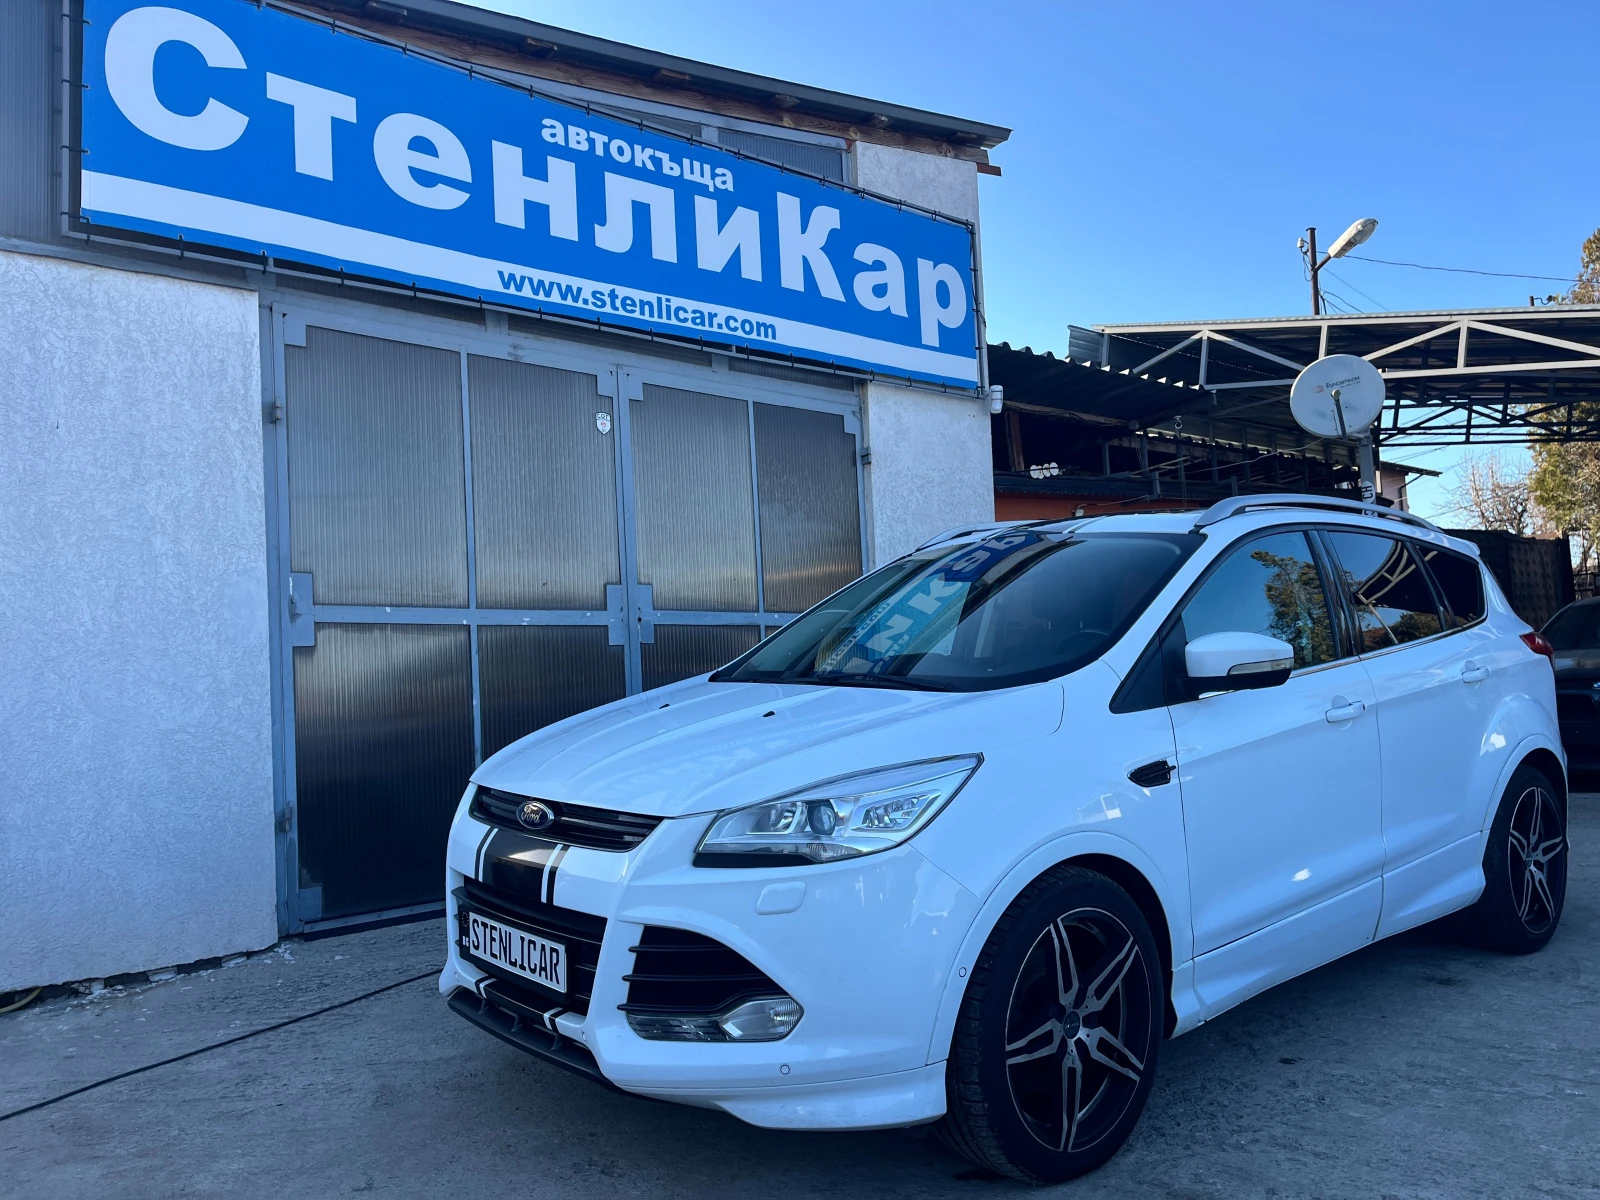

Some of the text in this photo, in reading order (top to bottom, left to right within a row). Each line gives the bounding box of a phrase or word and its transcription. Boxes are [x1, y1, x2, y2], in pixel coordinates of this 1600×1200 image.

[104, 6, 967, 347] СтенлиКар
[541, 117, 734, 192] автокъща
[498, 270, 777, 340] www.stenlicar.com
[521, 804, 542, 823] Ford
[471, 918, 561, 986] STENLICAR
